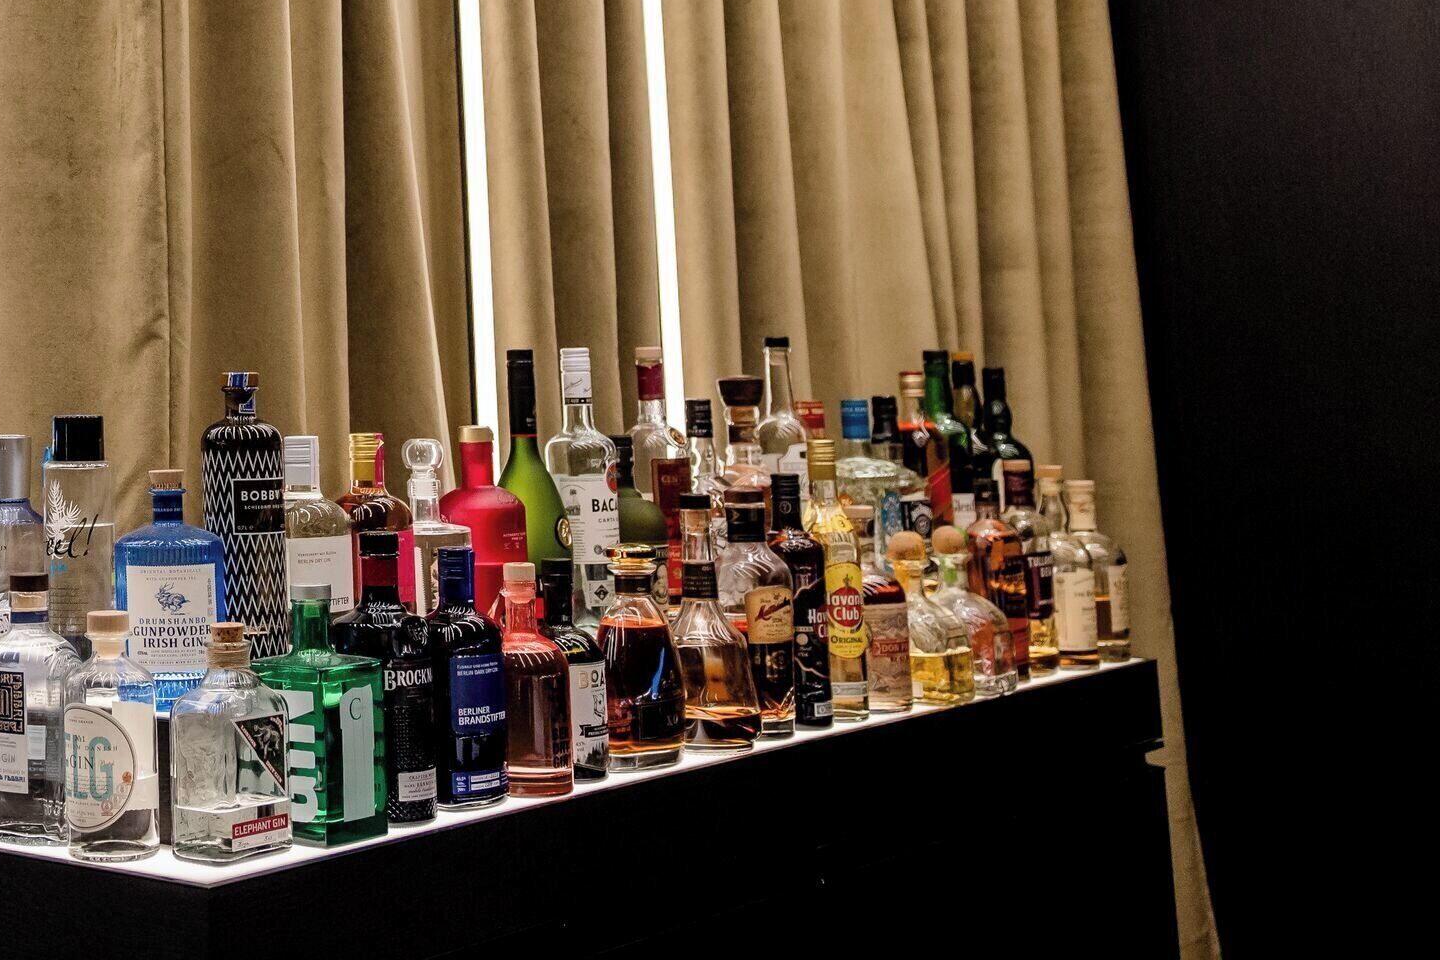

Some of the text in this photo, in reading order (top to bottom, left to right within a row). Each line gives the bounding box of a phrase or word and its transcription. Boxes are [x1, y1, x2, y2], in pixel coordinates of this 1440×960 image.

[833, 607, 860, 621] Club
[139, 617, 206, 625] DRUMSHANBO
[133, 625, 212, 637] GUNPOWDER
[143, 636, 204, 648] IRISH GIN
[458, 705, 490, 716] BERLINER
[458, 711, 506, 726] BRANDSTIFTER
[69, 754, 94, 770] GIN
[234, 816, 286, 837] ELEPHANT GIN
